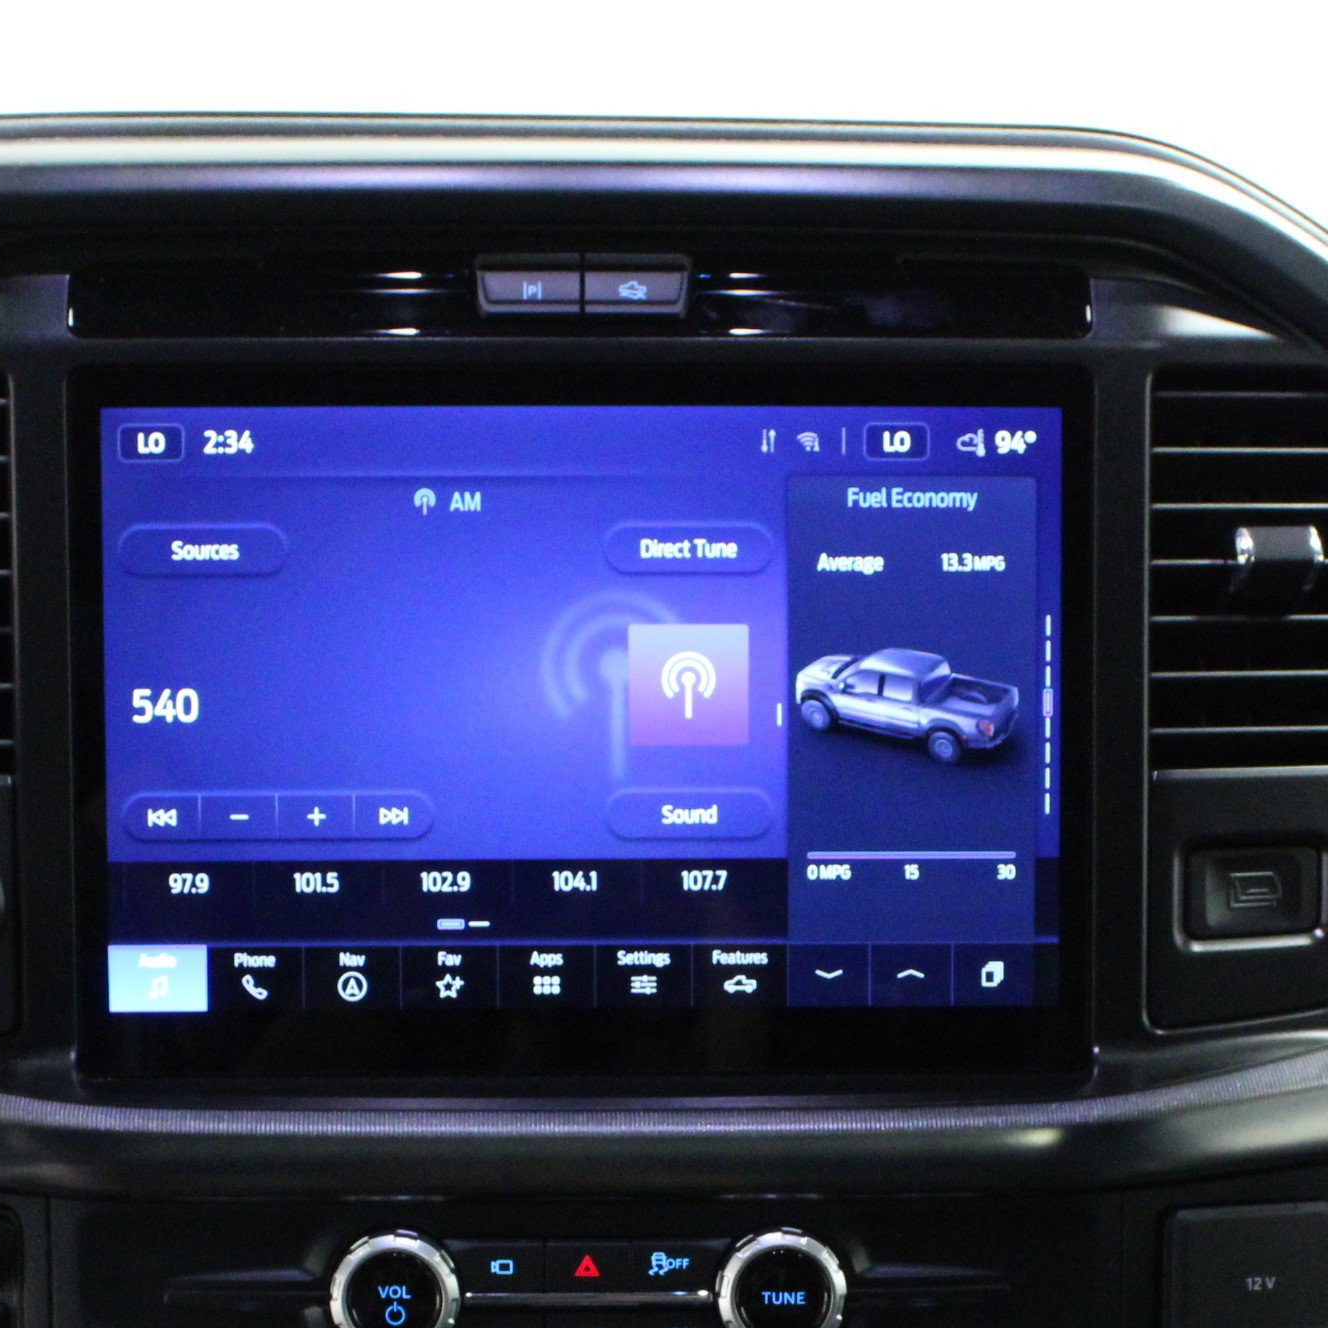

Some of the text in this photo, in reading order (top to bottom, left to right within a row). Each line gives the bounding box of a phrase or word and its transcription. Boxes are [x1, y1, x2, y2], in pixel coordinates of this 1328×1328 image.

[136, 430, 166, 456] LO
[202, 428, 254, 456] 2:34
[881, 430, 912, 454] LO
[994, 428, 1038, 456] 94°
[448, 490, 482, 513] AM
[846, 486, 978, 512] Fuel Economy
[170, 538, 240, 562] Sources
[639, 537, 738, 560] Direct Tune
[816, 551, 885, 577] Average
[131, 686, 201, 725] 540
[660, 804, 718, 826] Sound
[167, 872, 210, 895] 97.9
[292, 871, 340, 894] 101.5
[419, 870, 472, 894] 102.9
[551, 870, 598, 893] 104.1
[680, 869, 728, 892] 107.7
[806, 864, 852, 881] 0 MPG
[903, 864, 920, 881] 15
[996, 864, 1017, 881] 30
[233, 951, 276, 969] Phone
[338, 951, 366, 968] Nav
[436, 951, 462, 968] Fav
[530, 950, 564, 970] Apps
[616, 949, 671, 970] Settings
[711, 949, 769, 967] Features
[666, 1258, 690, 1270] OFF
[378, 1285, 411, 1300] VOL
[1245, 1276, 1277, 1292] 12 V
[761, 1291, 806, 1306] TUNE
